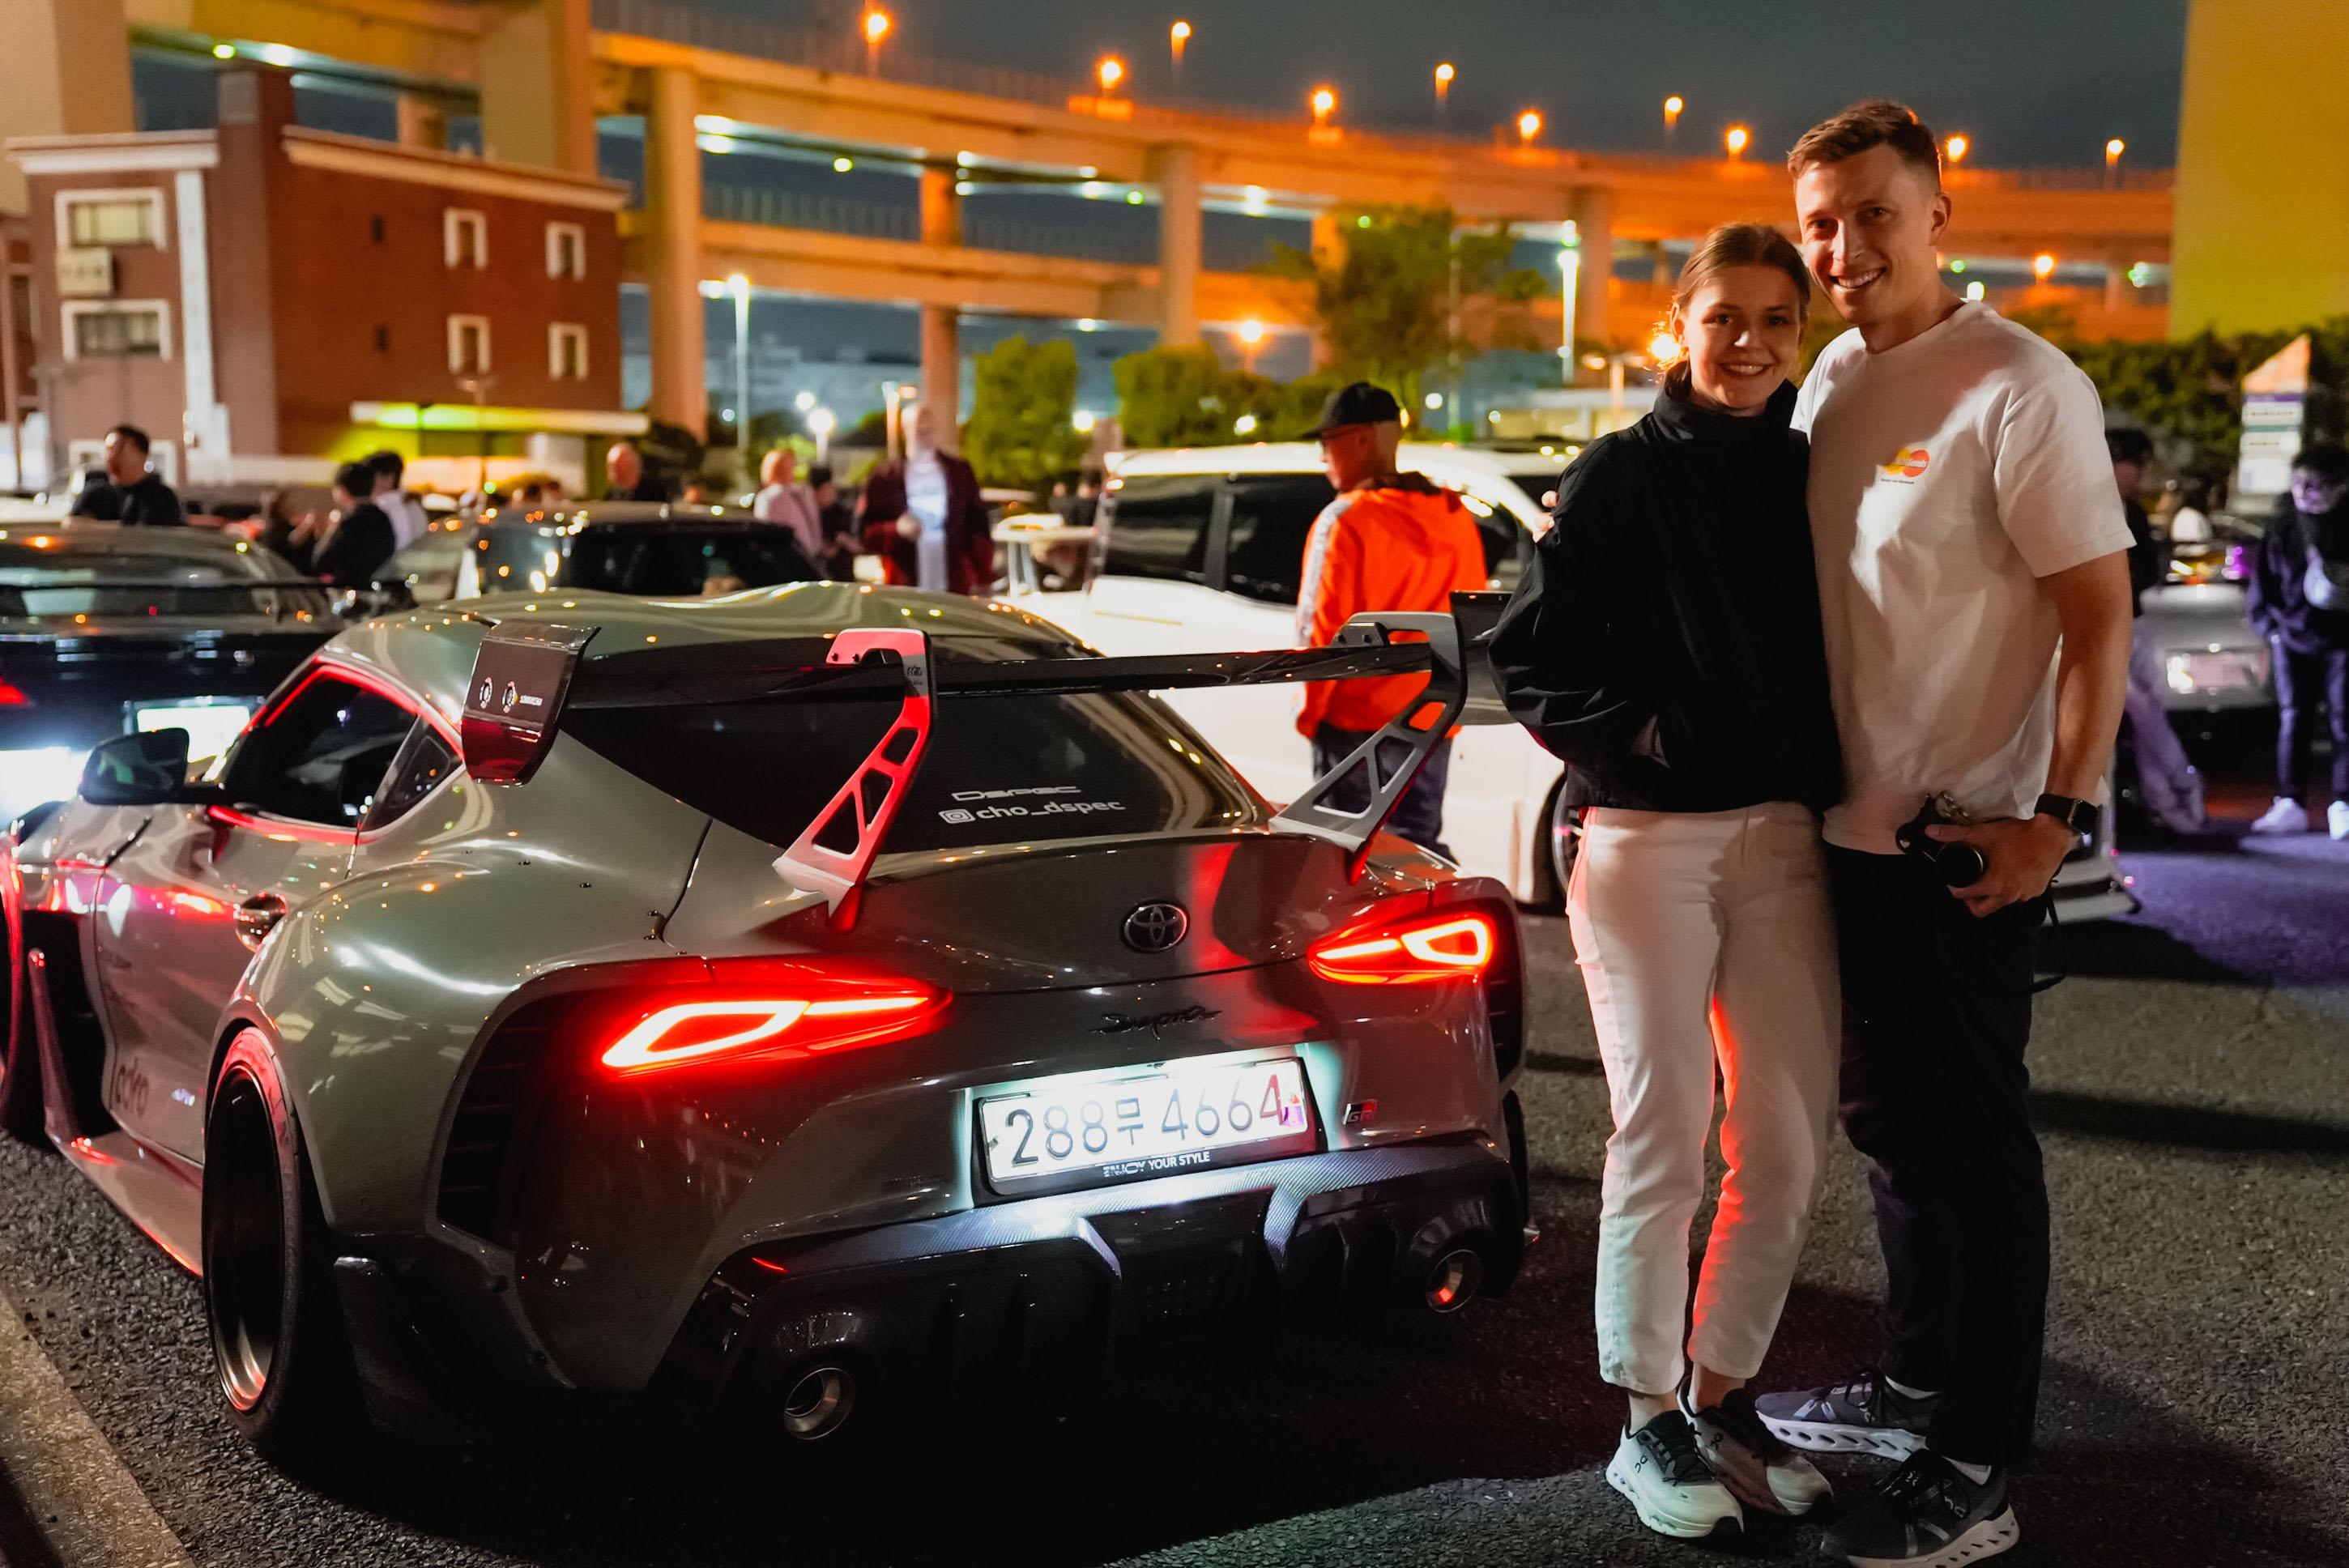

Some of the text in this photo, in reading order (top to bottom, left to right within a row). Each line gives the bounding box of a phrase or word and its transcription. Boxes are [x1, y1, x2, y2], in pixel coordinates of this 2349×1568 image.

[975, 801, 1126, 819] cho_dspec
[1005, 1073, 1285, 1165] 288무 4664
[1148, 1157, 1178, 1170] YOUR
[1179, 1151, 1211, 1165] STYLE
